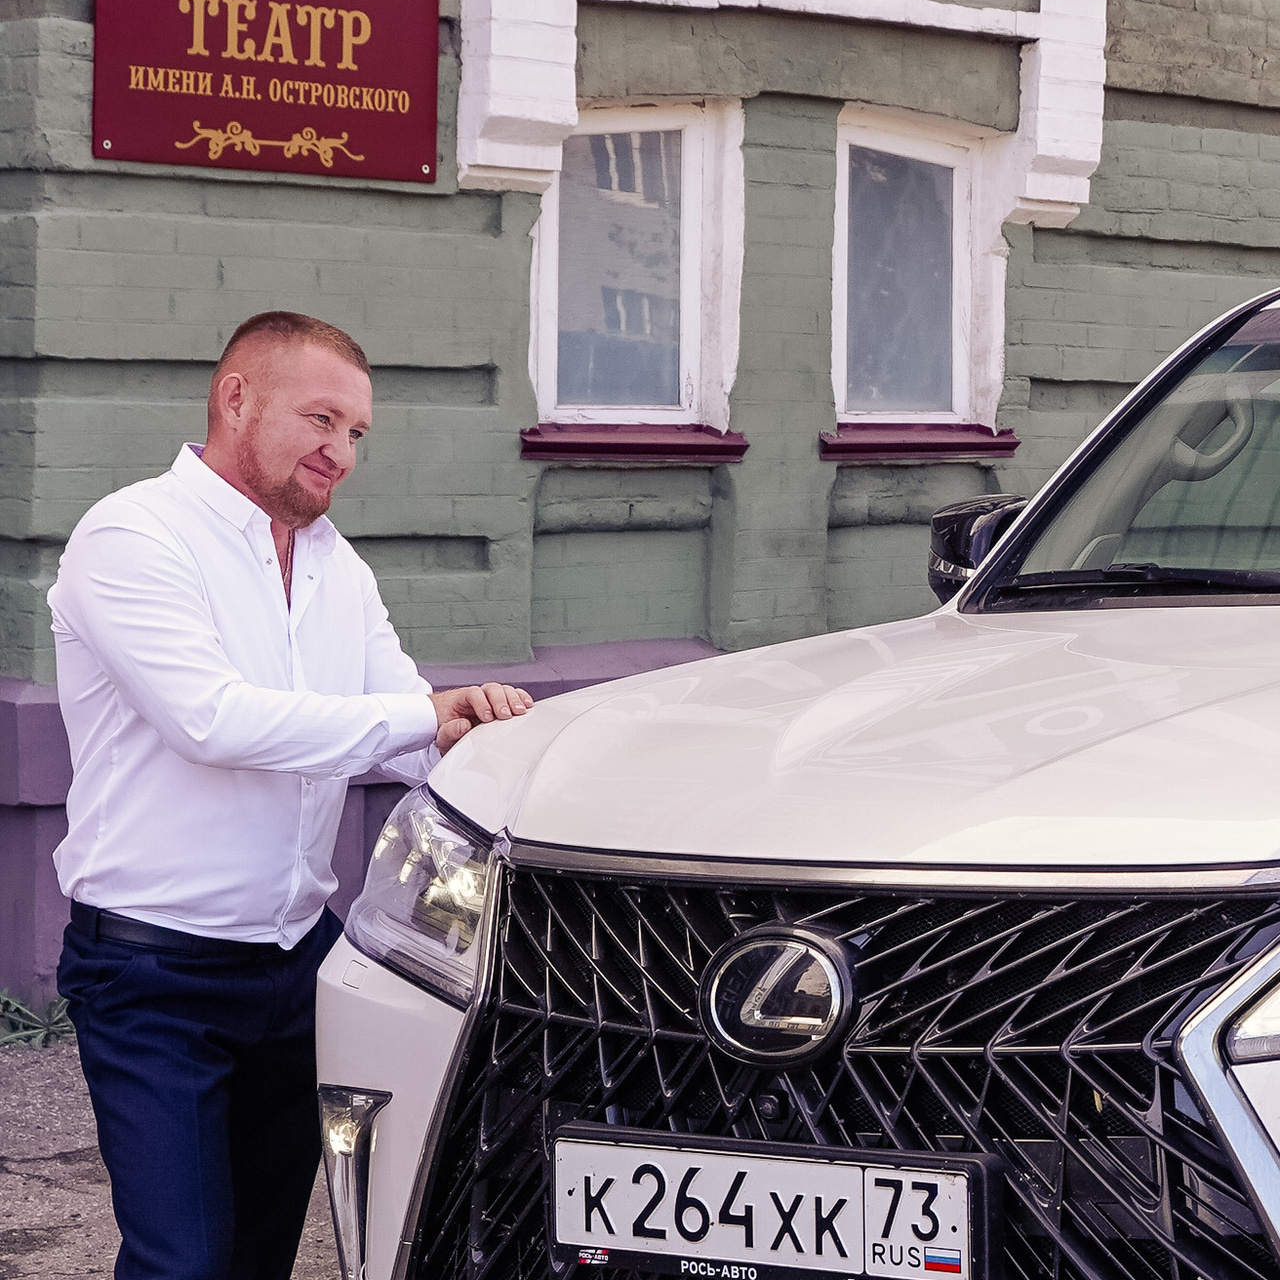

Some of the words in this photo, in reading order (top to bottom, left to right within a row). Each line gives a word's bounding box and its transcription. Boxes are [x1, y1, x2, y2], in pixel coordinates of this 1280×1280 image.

[128, 65, 213, 96] ИМЕНИ
[219, 74, 263, 100] А.Н.
[269, 78, 410, 113] ОСТРОВСКОГО
[874, 1177, 939, 1242] 73
[579, 1252, 609, 1261] РОСЬ-АВТО
[872, 1242, 921, 1268] RUS
[680, 1260, 758, 1280] РОСЬ-АВТО
